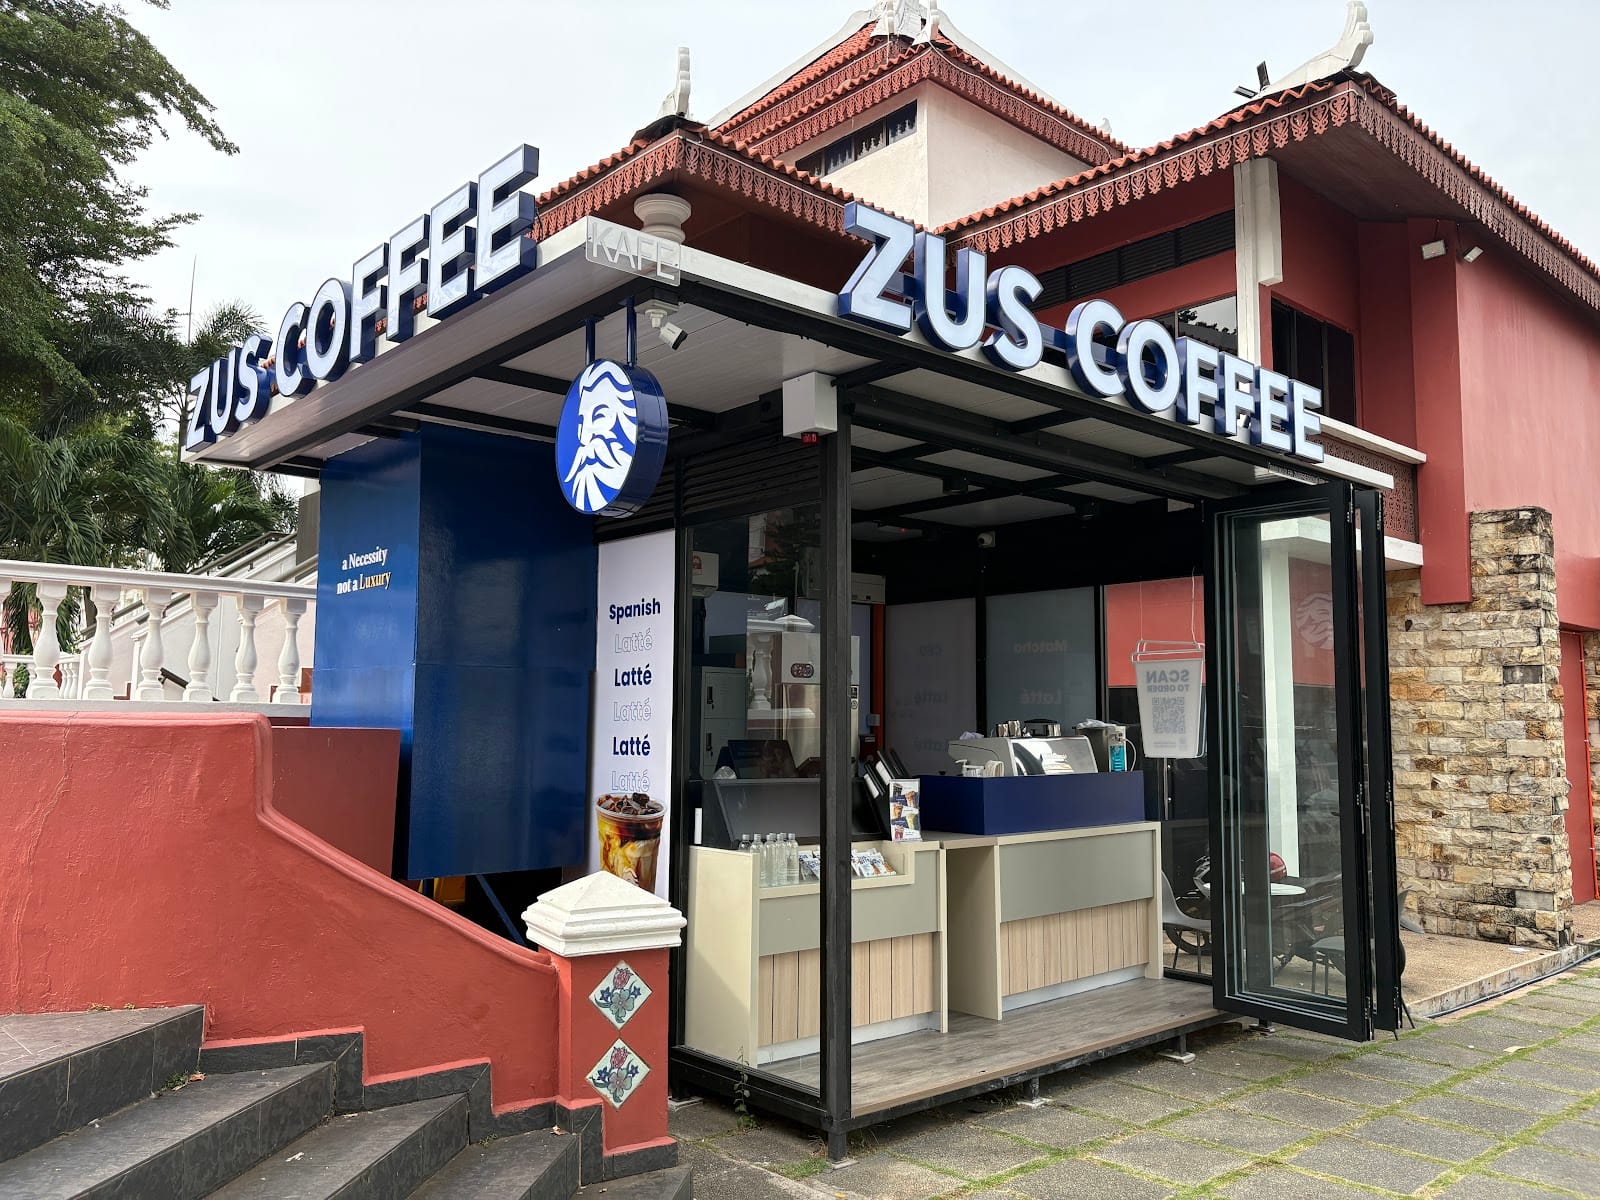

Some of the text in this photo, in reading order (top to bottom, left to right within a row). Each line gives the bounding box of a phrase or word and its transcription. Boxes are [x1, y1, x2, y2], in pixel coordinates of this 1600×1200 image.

[592, 222, 675, 280] KAFE
[185, 143, 539, 452] ZUS COFFEE
[838, 201, 1324, 463] ZUS COFFEE
[342, 546, 388, 571] a Necessity
[336, 571, 392, 595] not a Luxury
[609, 598, 661, 624] Spanish
[615, 628, 653, 653] Latté
[614, 664, 652, 687] Latté
[613, 698, 652, 721] Latté
[612, 734, 651, 757] Latté
[611, 769, 650, 793] Latté
